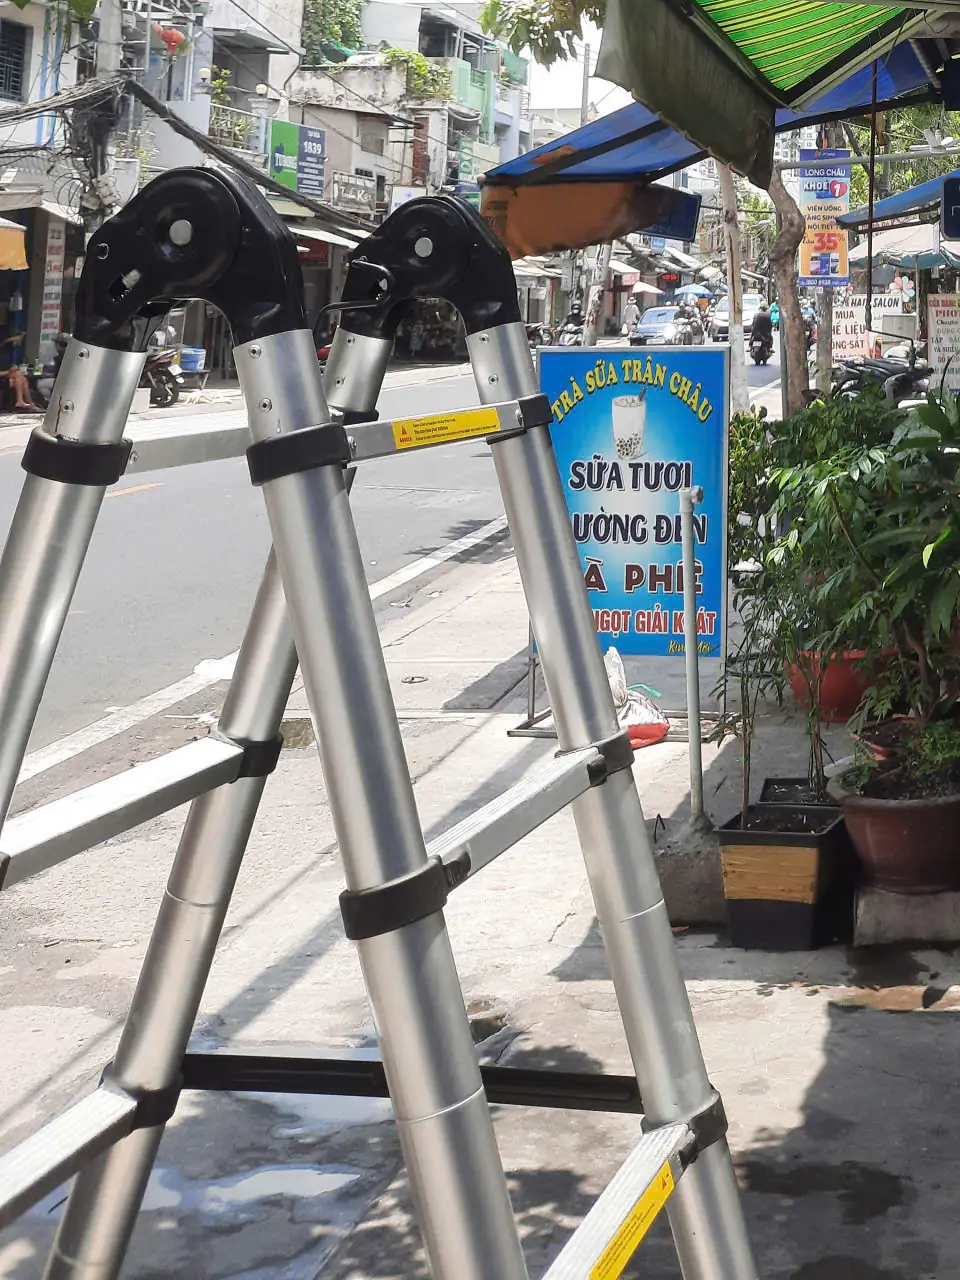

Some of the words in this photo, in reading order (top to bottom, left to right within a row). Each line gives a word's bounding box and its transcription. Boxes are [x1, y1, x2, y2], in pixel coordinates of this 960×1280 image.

[303, 140, 322, 155] 1839
[826, 167, 846, 177] CHÂU
[872, 297, 900, 308] SALON
[835, 310, 855, 320] MUA
[551, 376, 584, 424] TRÀ
[585, 359, 619, 393] SỮA
[621, 355, 667, 388] TRÂN
[669, 371, 714, 424] CHÂU
[568, 454, 625, 492] SỮA
[628, 460, 694, 492] TƯƠI
[572, 506, 648, 544] ƯỜNG
[635, 603, 669, 634] GIẢI
[673, 606, 717, 634] KÁT
